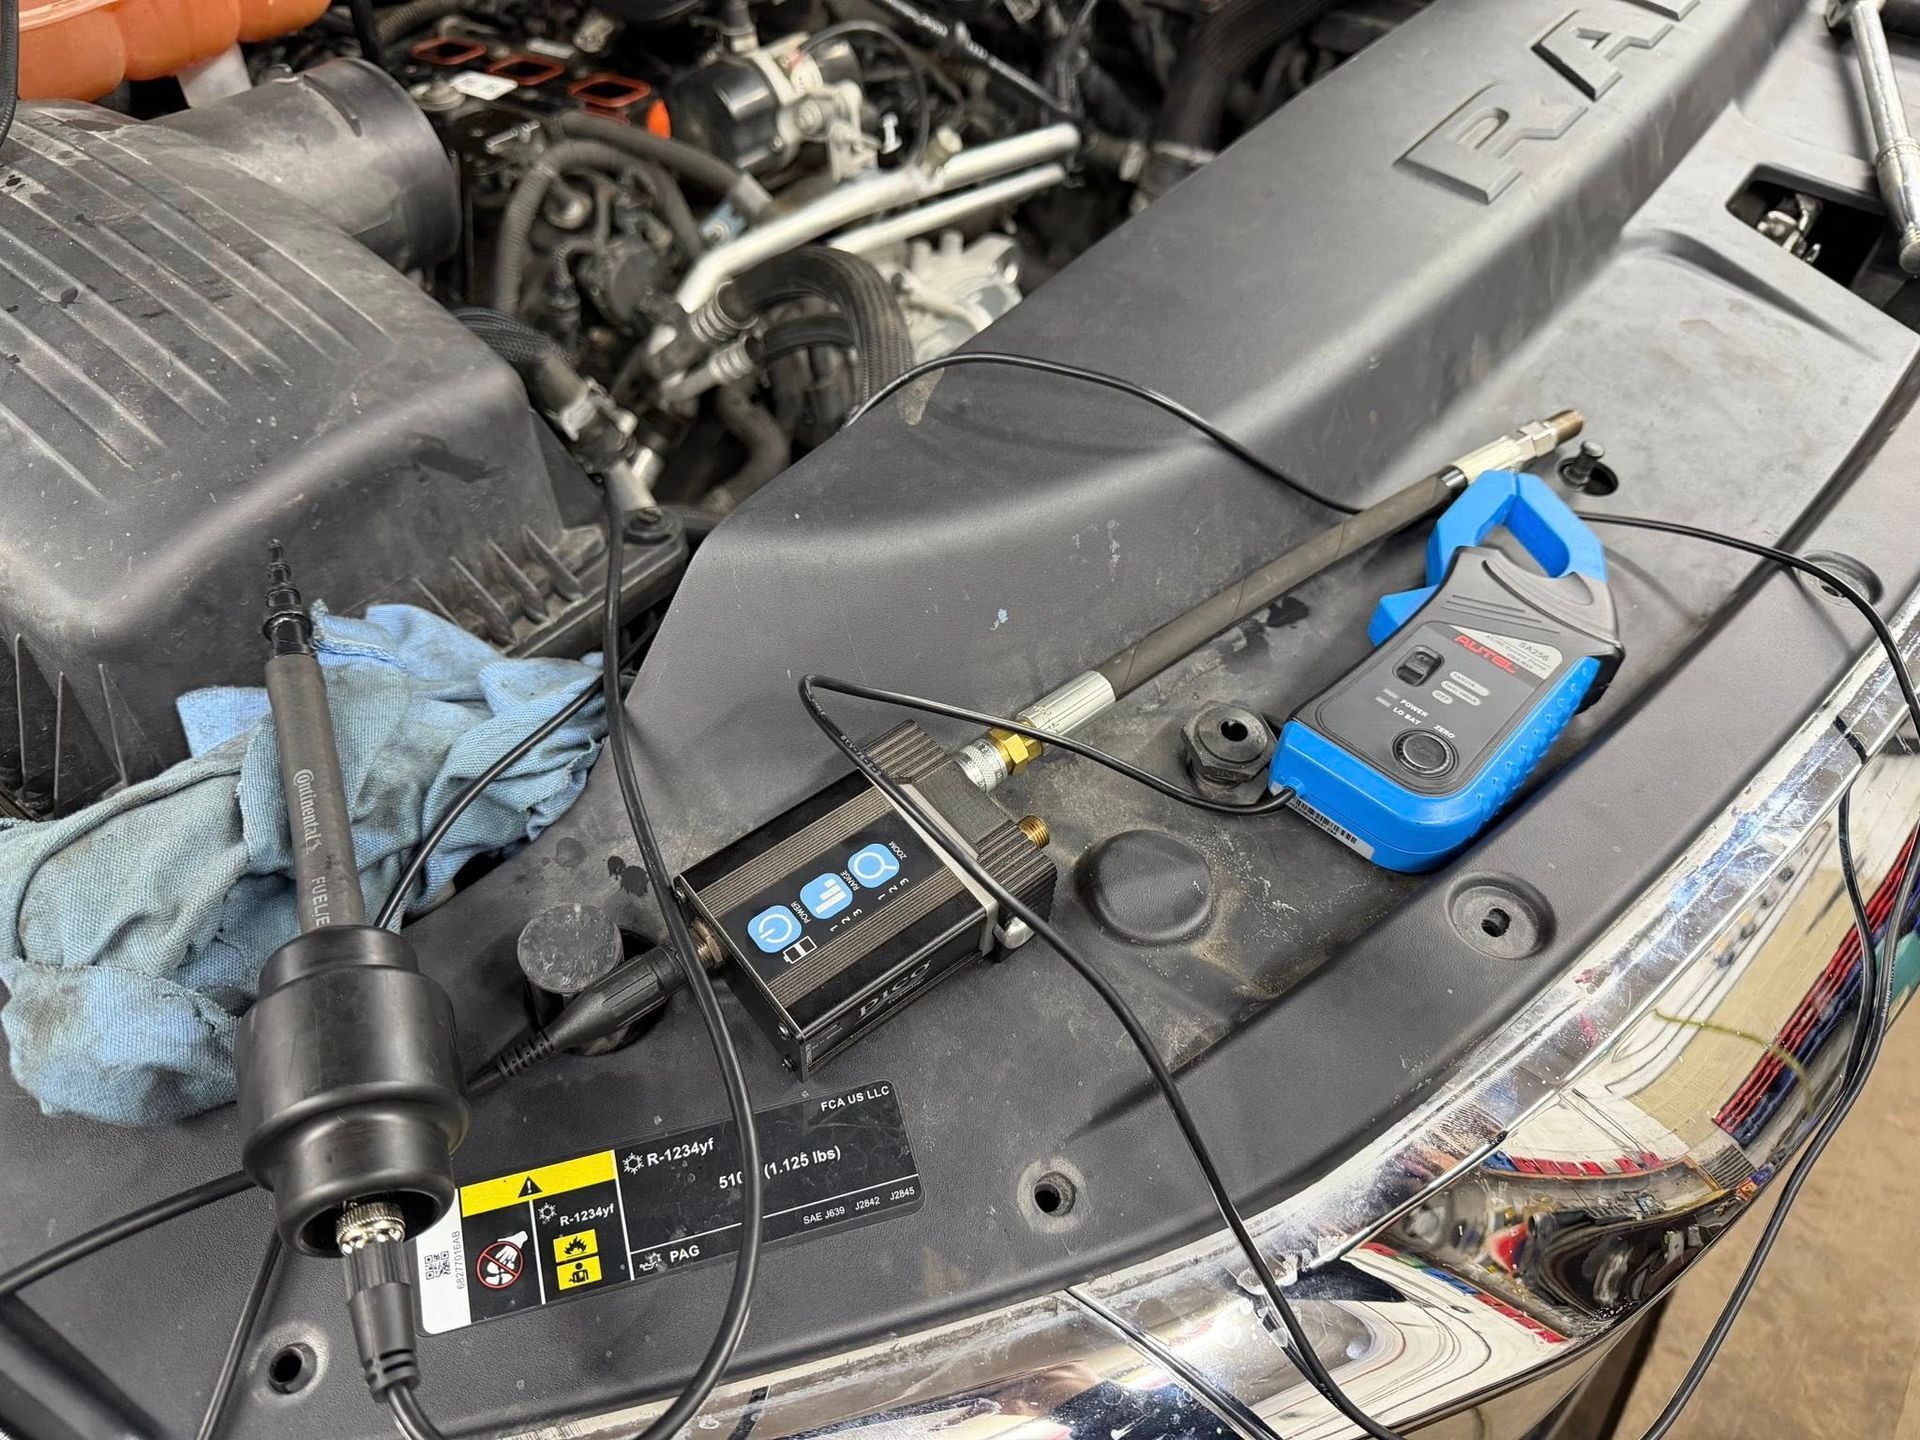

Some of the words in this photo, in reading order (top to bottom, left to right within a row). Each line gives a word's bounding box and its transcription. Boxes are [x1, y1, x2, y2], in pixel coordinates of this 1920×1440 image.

[1393, 0, 1699, 205] RA
[1454, 634, 1516, 675] AUTEL
[1392, 707, 1405, 715] LO
[1404, 713, 1422, 725] BAT
[1400, 699, 1429, 717] POWER
[1433, 724, 1455, 739] ZERO
[293, 768, 322, 847] Continental
[888, 840, 908, 860] ZOOM
[840, 870, 860, 891] RANGE
[877, 893, 886, 901] 1
[888, 885, 898, 893] 2
[899, 877, 909, 886] 3
[790, 900, 812, 925] POWER
[830, 924, 839, 932] 1
[841, 915, 851, 925] 2
[853, 908, 863, 917] 3
[820, 1097, 846, 1112] FCA
[849, 1091, 865, 1105] US
[866, 1085, 891, 1101] LLC
[646, 1137, 715, 1168] R-1234yf
[763, 1152, 810, 1180] (1.125
[813, 1145, 841, 1165] lbs)
[559, 1203, 616, 1227] R-1234yf
[803, 1212, 823, 1226] SAE
[825, 1206, 846, 1219] J639
[855, 1196, 881, 1211] J2842
[889, 1186, 915, 1201] J2845
[451, 1230, 465, 1290] 68277016AB
[669, 1245, 700, 1263] PAG
